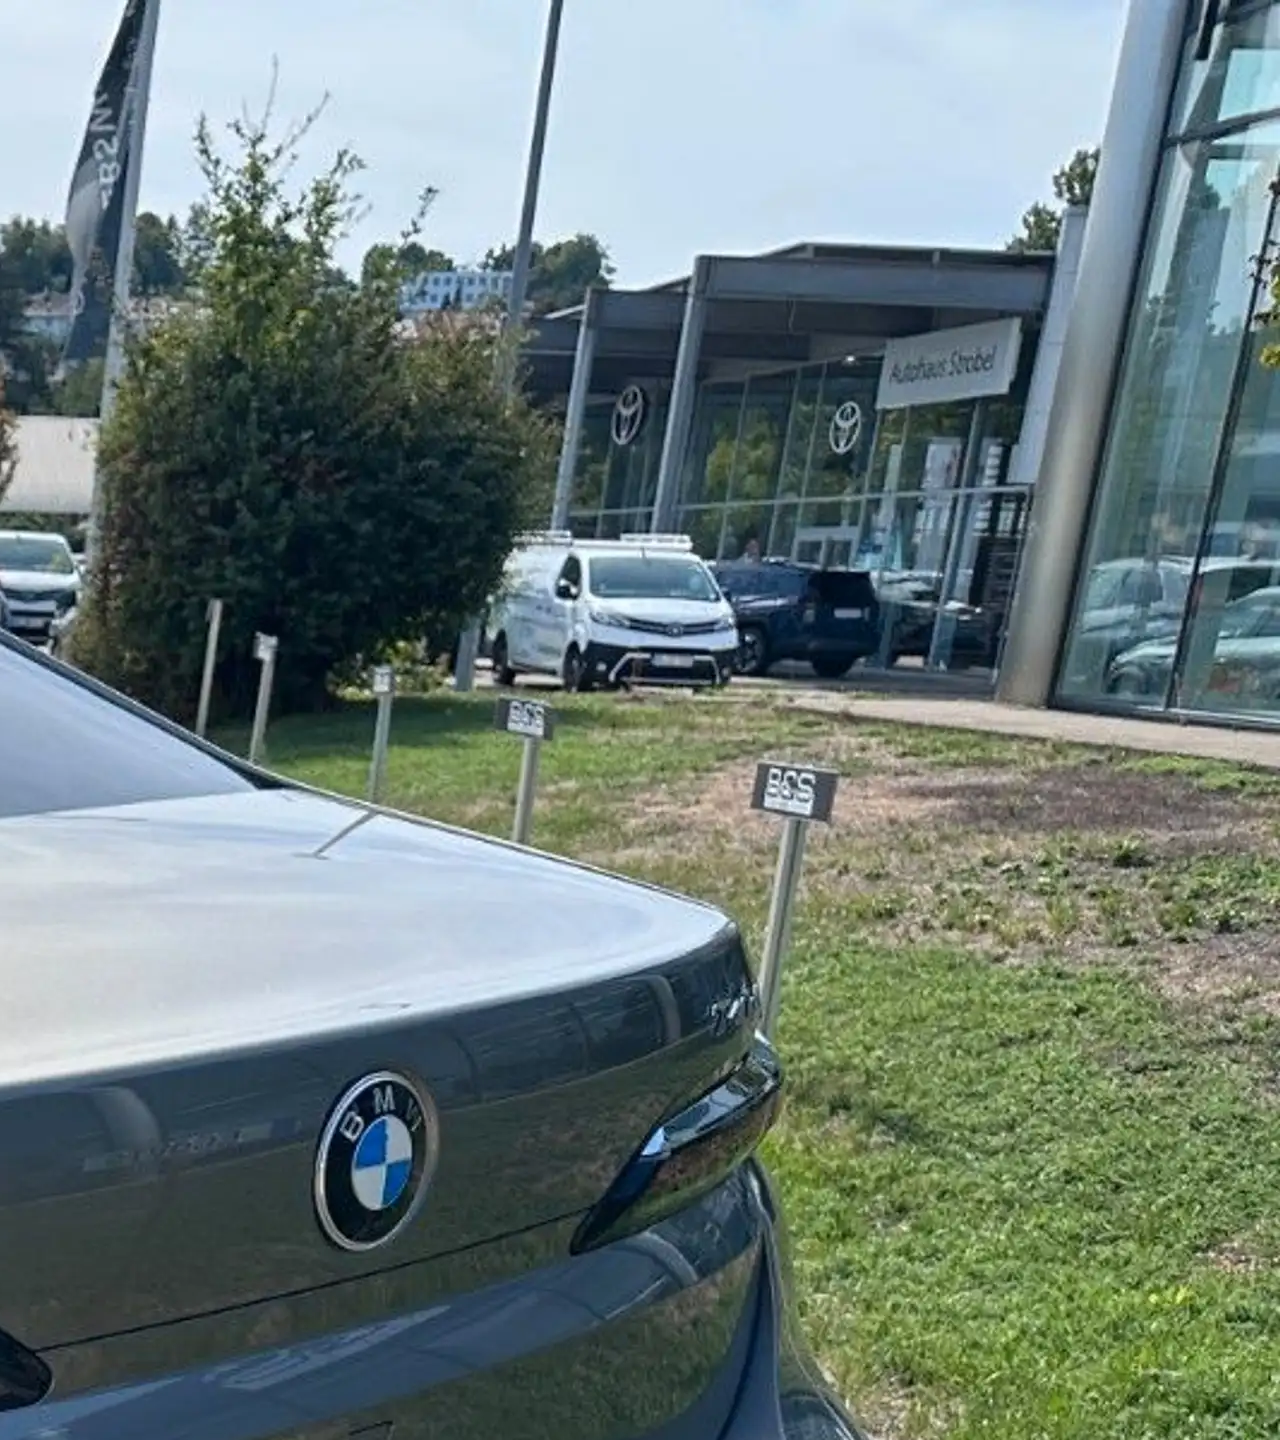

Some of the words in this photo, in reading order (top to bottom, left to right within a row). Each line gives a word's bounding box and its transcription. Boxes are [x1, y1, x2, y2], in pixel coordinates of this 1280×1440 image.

[891, 356, 946, 383] Autohaus
[949, 344, 998, 376] Strobel
[766, 767, 816, 803] B&S
[340, 1084, 422, 1143] BMW
